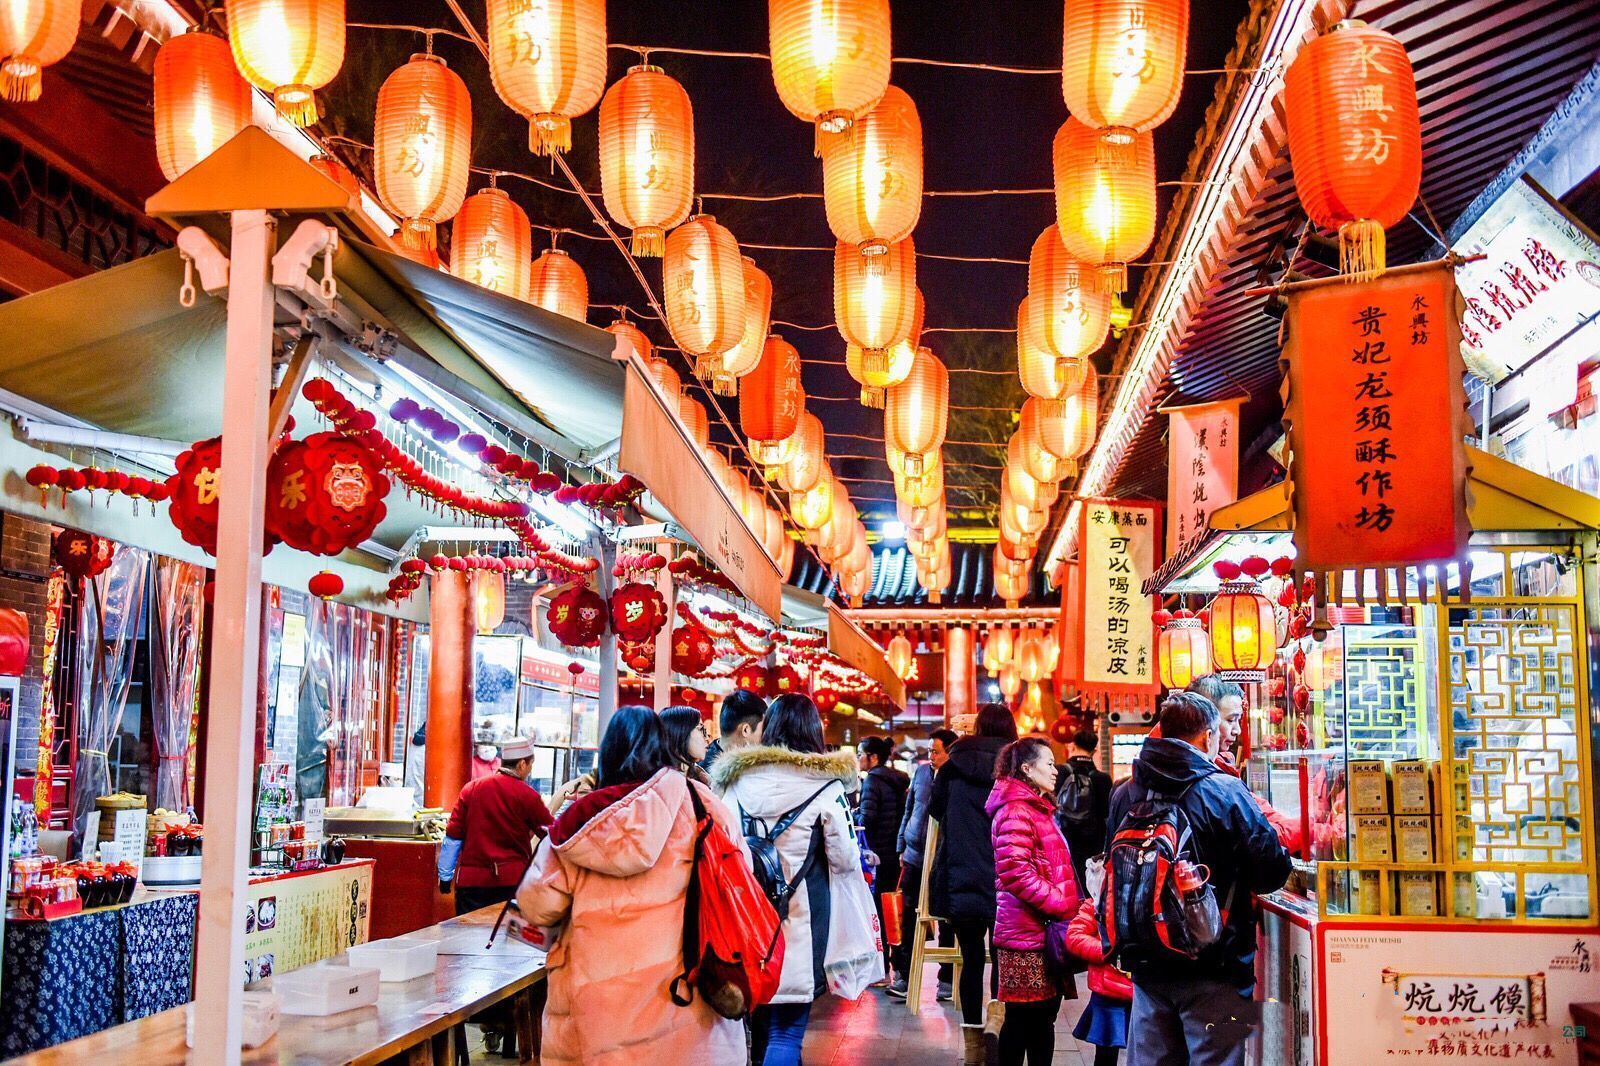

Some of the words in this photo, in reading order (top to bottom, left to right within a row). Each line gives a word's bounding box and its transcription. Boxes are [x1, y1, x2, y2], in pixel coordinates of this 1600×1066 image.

[1340, 38, 1398, 165] 永興坊
[1409, 293, 1430, 346] 永興坊
[782, 351, 800, 420] 永興坊
[1351, 306, 1398, 533] 贵妃龙须酥作坊
[1091, 510, 1148, 527] 安康蒸面
[556, 605, 570, 624] 岁
[624, 600, 644, 622] 岁
[1106, 537, 1131, 676] 可以喝汤的凉皮
[1404, 982, 1527, 1015] 炕炕馍
